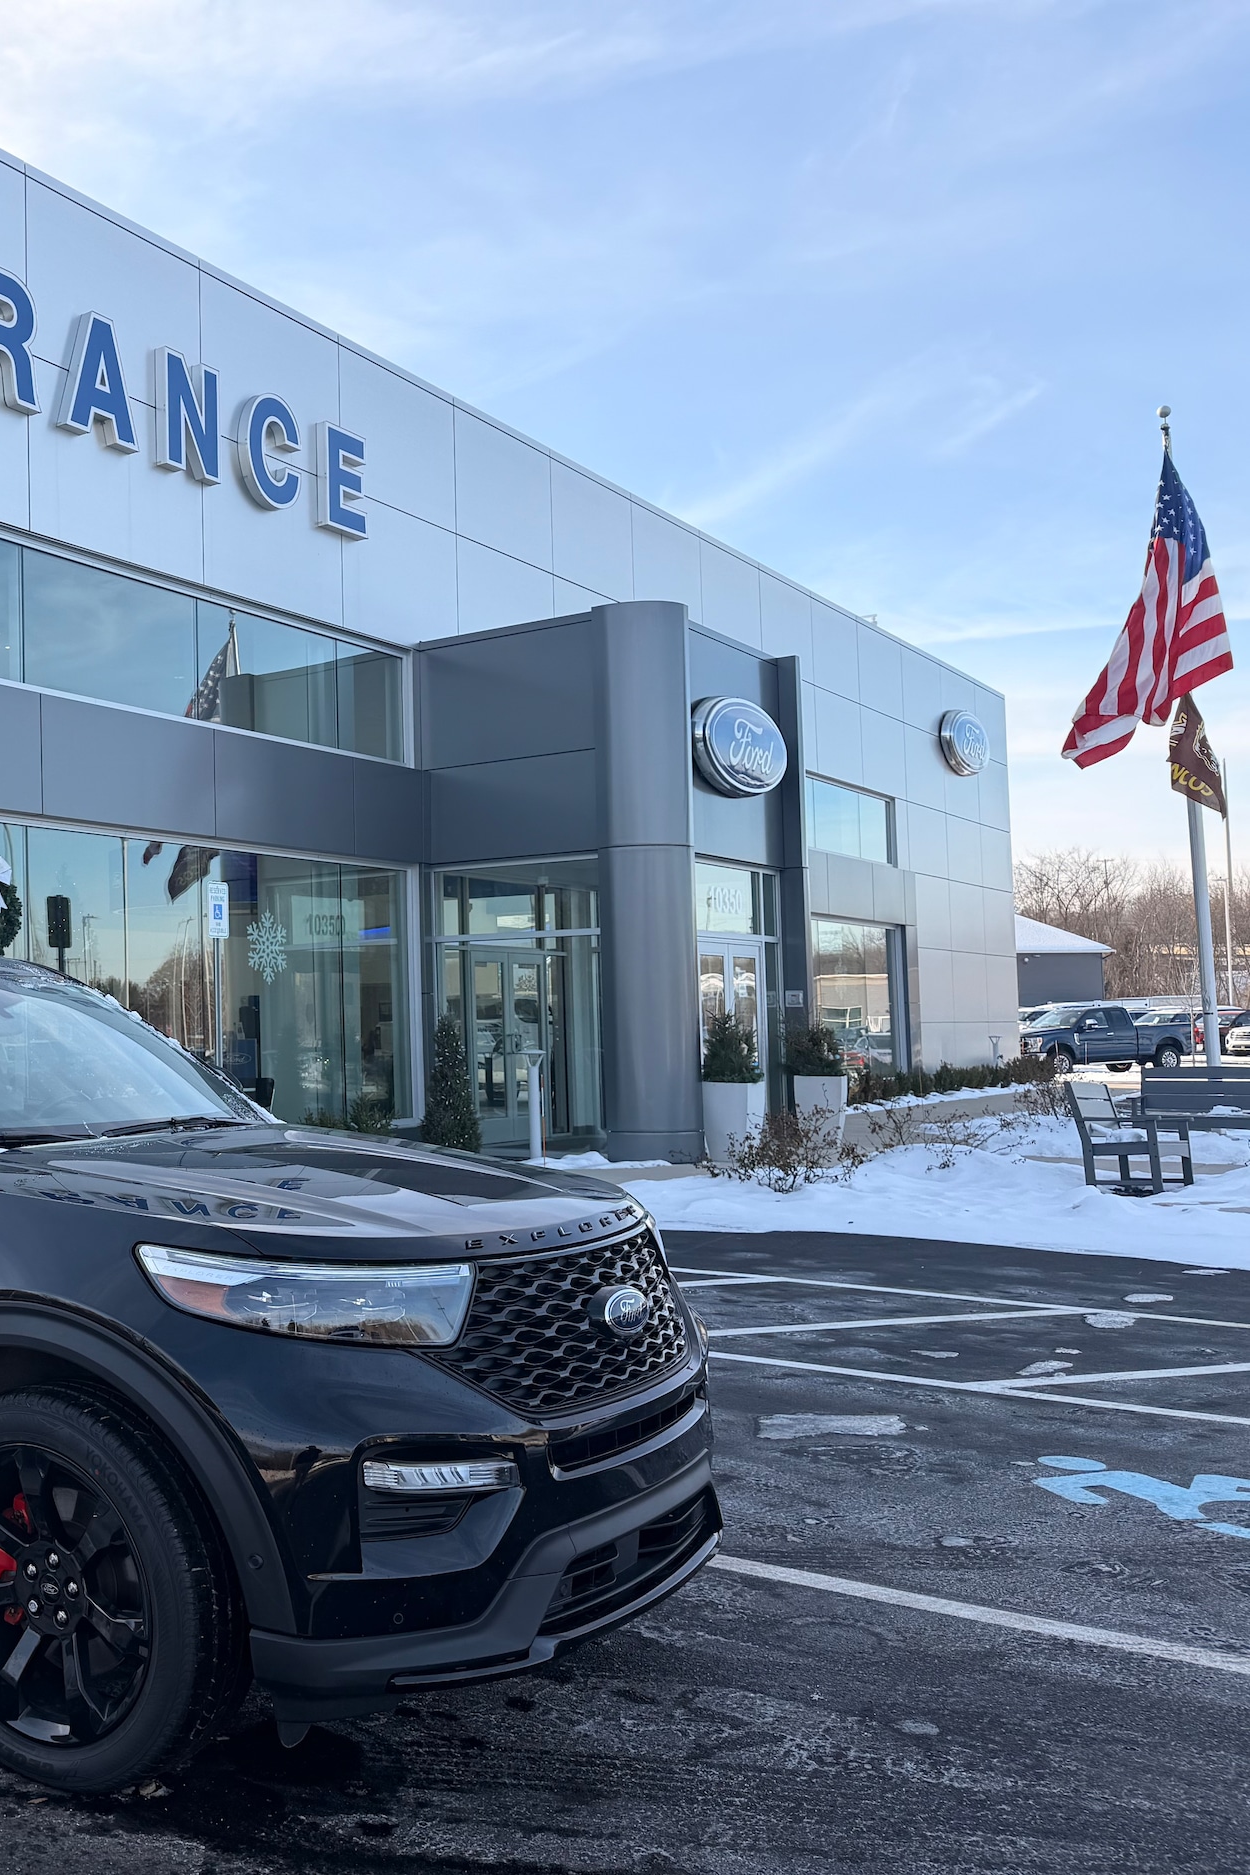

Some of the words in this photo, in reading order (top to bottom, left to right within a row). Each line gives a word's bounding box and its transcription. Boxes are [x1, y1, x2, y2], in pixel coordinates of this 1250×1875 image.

[728, 717, 775, 776] Ford
[962, 722, 987, 762] Ford
[707, 885, 743, 914] 10350
[464, 1204, 637, 1251] EXPLORER
[619, 1298, 647, 1323] Ford
[85, 1445, 149, 1536] YOKOHAMA
